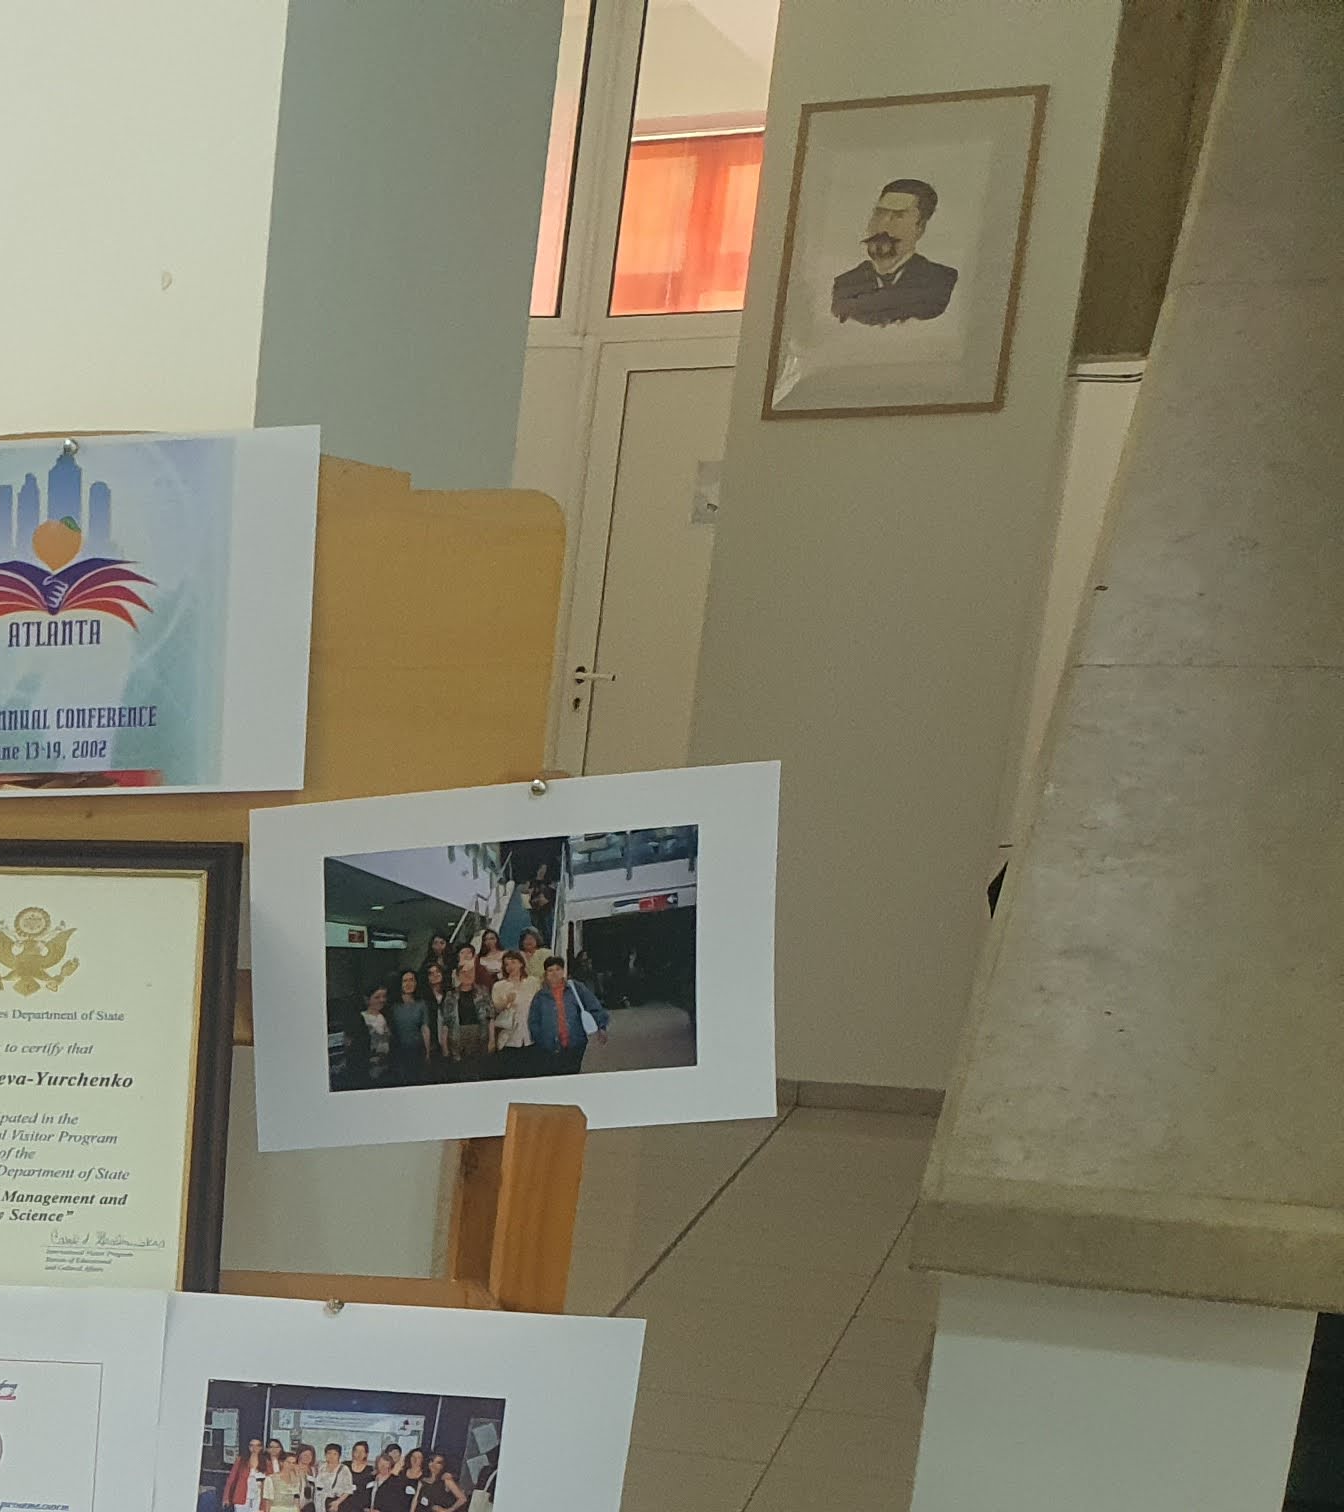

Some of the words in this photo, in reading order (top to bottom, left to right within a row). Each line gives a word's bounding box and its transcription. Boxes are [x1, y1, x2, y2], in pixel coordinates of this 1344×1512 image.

[8, 620, 101, 648] ATLANTA
[56, 706, 157, 729] CONFERENCE
[72, 740, 107, 759] 2002
[12, 1009, 77, 1022] Department
[81, 1010, 95, 1021] of
[96, 1010, 125, 1022] State
[4, 1041, 18, 1053] to
[21, 1042, 64, 1056] certify
[67, 1042, 94, 1055] that
[41, 1113, 55, 1125] in
[57, 1113, 79, 1125] the
[10, 1129, 55, 1142] Visitor
[58, 1130, 118, 1146] Program
[15, 1147, 36, 1160] the
[77, 1167, 95, 1182] of
[95, 1167, 130, 1181] State
[1, 1190, 96, 1207] Management
[99, 1193, 128, 1206] and
